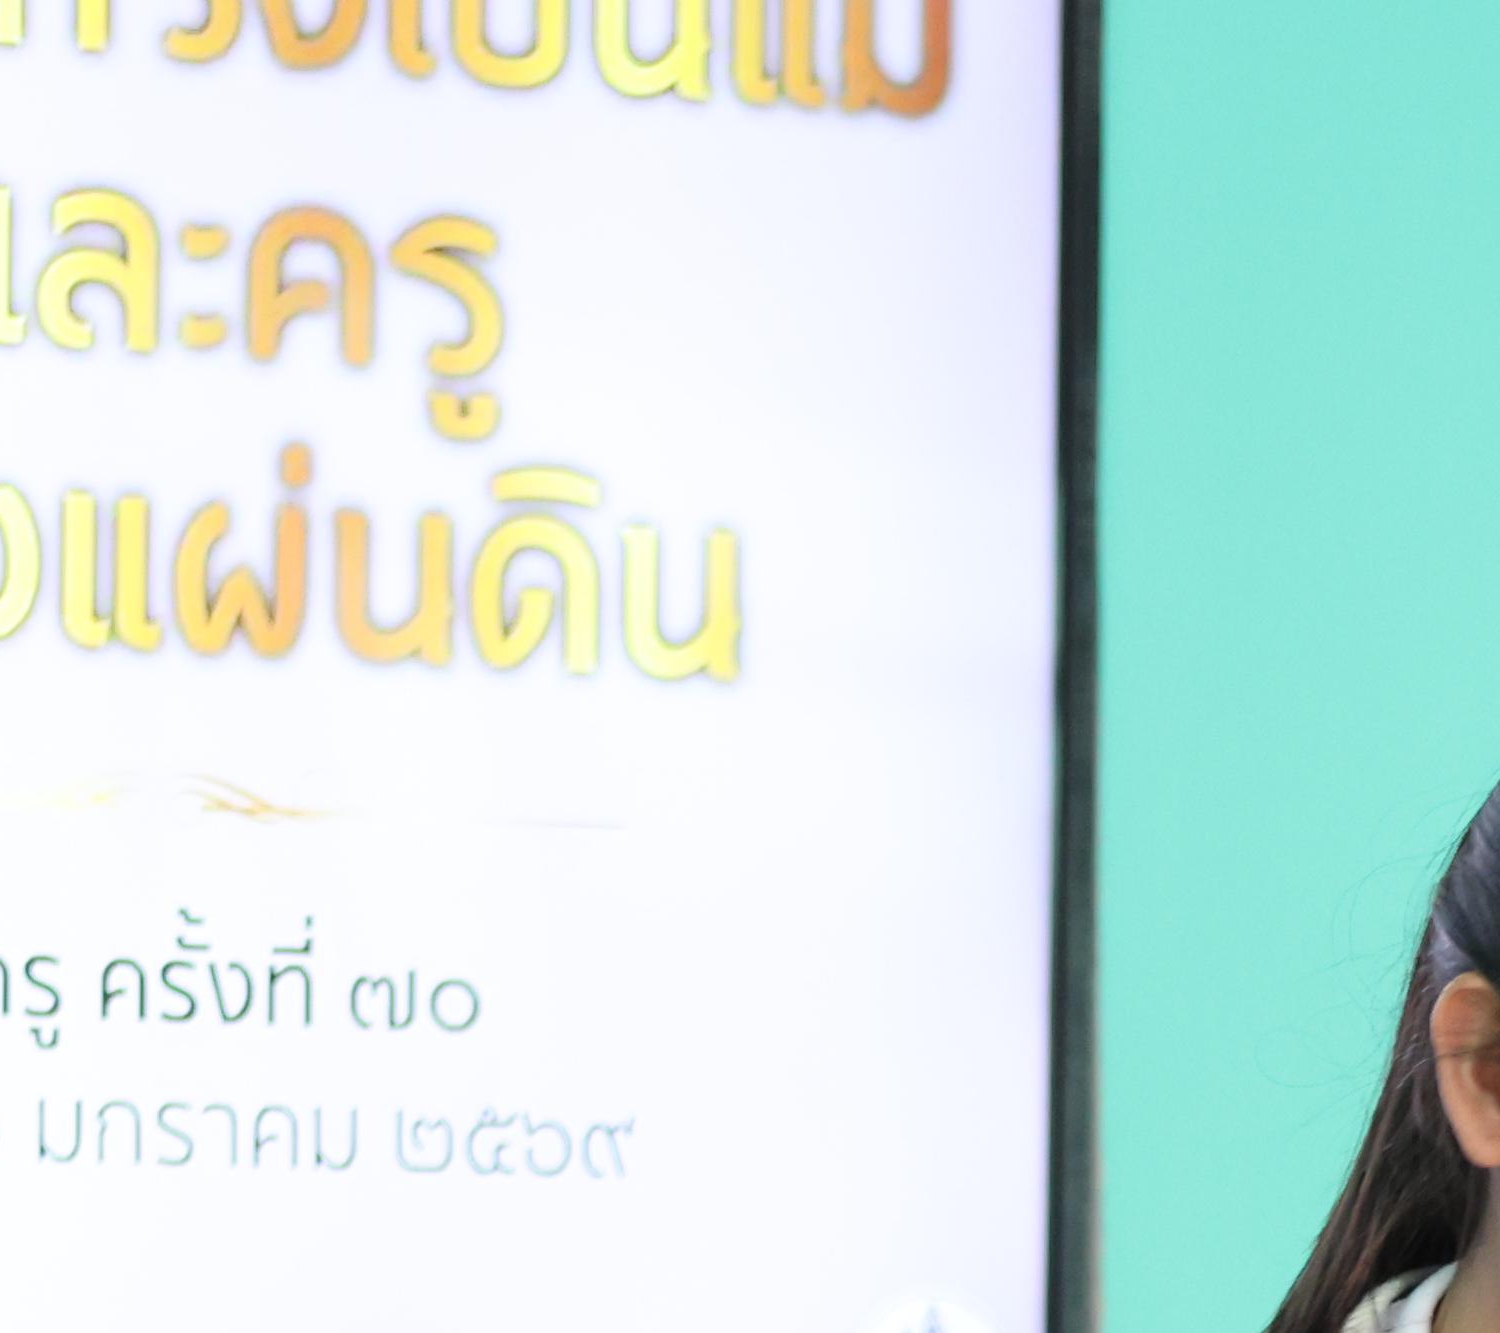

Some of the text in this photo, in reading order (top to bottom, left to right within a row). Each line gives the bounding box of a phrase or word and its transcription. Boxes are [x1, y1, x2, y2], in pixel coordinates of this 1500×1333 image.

[98, 908, 321, 1034] ครั้งที่
[349, 967, 483, 1034] ๗๐
[33, 1096, 361, 1176] มกราคม
[391, 1104, 638, 1182] ๒๕๖๙
